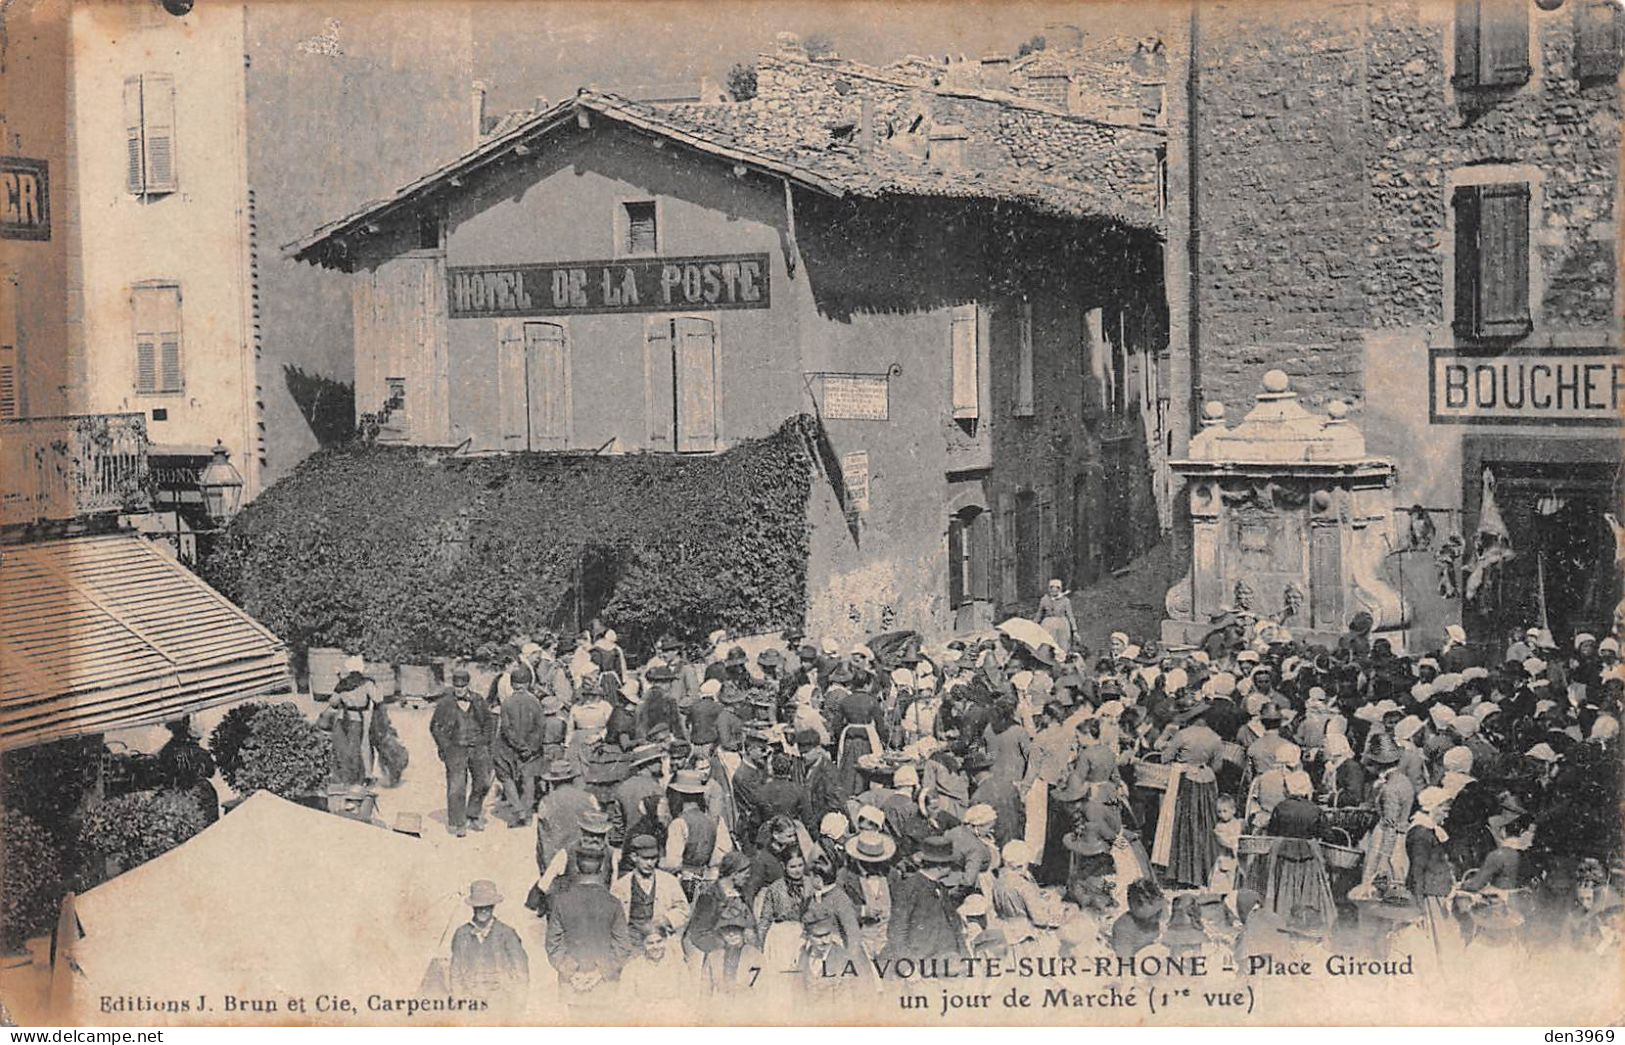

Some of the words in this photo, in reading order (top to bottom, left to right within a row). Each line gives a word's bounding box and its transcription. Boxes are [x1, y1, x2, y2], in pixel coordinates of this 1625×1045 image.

[455, 270, 532, 311] HOTEL
[552, 268, 588, 308] DE
[601, 266, 640, 306] LA
[661, 261, 761, 304] POSTE
[749, 966, 761, 987] 7
[821, 959, 859, 978] LA
[871, 957, 1208, 978] VOULTE-SUR-RHONE
[1248, 955, 1311, 976] Place
[1325, 954, 1413, 976] Giroud
[100, 996, 190, 1013] Editions
[196, 996, 213, 1012] J.
[224, 995, 278, 1012] Brun
[287, 997, 306, 1012] et
[315, 995, 357, 1014] Cie,
[367, 994, 489, 1016] Carpentras
[900, 994, 928, 1009] un
[940, 988, 992, 1016] jour
[1003, 988, 1031, 1008] de
[1042, 986, 1137, 1008] Marché
[1203, 985, 1255, 1014] vue)
